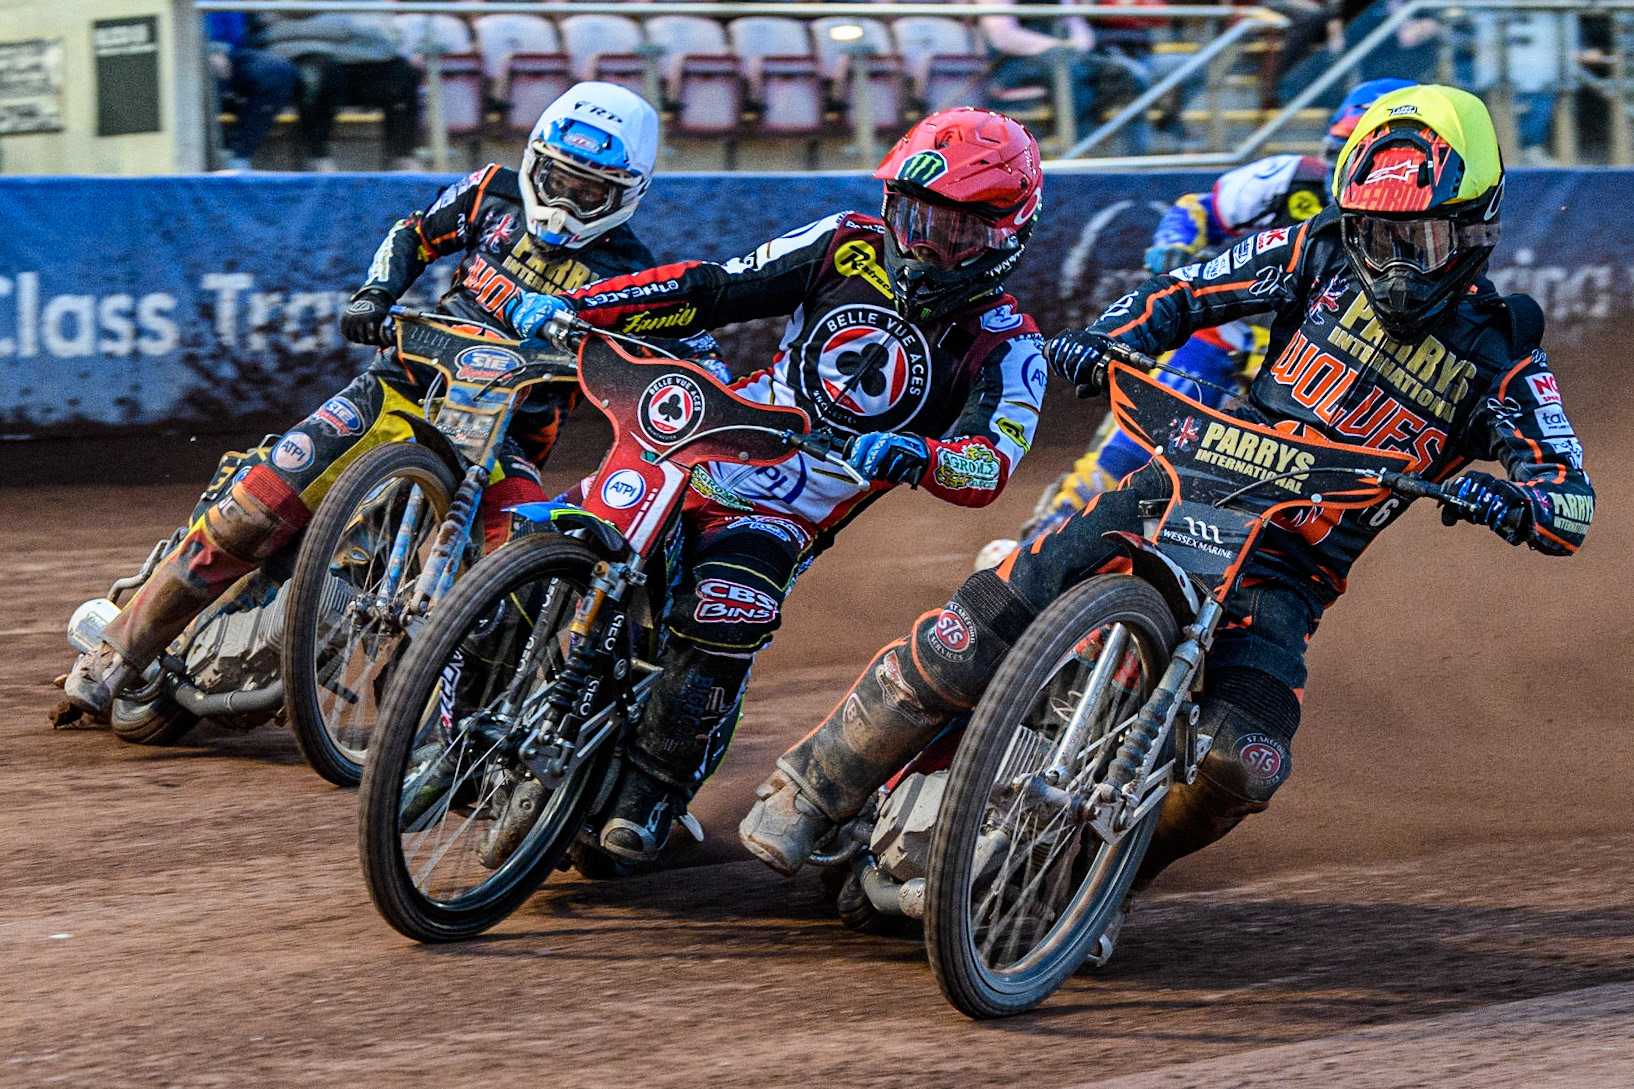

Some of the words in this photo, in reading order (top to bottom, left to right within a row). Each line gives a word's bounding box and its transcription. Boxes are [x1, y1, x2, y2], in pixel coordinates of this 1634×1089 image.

[826, 311, 878, 333] BELLE
[886, 317, 916, 348] VUE
[909, 353, 925, 397] ACES
[648, 377, 673, 395] BELLE
[675, 377, 692, 390] VUE
[690, 390, 702, 412] ACES
[282, 440, 306, 462] ATPI
[1201, 421, 1315, 480] PARRYS
[1194, 448, 1302, 495] INTERNATIONAL
[609, 480, 637, 498] ATPI
[1369, 497, 1399, 528] 6
[1163, 528, 1198, 548] WESSEX
[1198, 541, 1233, 559] MARINE
[701, 582, 774, 610] CBS
[937, 616, 965, 645] STS
[1248, 747, 1276, 772] STS
